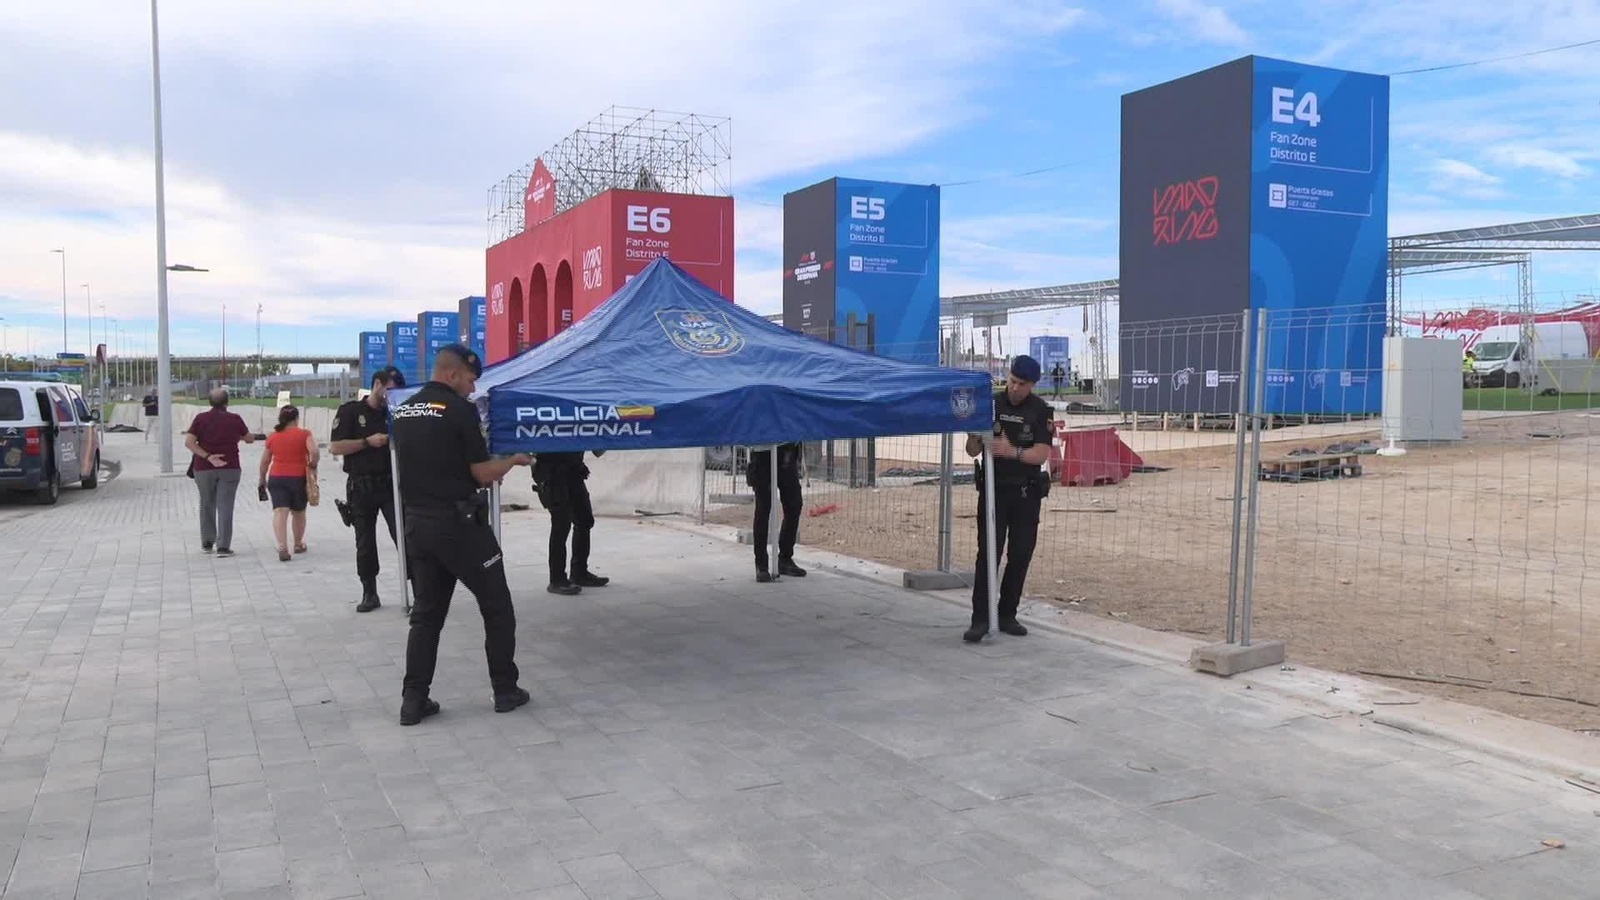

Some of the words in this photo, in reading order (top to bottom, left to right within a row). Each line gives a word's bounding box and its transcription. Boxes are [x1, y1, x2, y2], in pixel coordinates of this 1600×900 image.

[1272, 87, 1320, 127] E4
[1270, 131, 1290, 144] Fan
[1291, 133, 1317, 148] Zone
[1270, 147, 1308, 162] Distrito
[1309, 151, 1317, 163] E
[851, 195, 886, 221] E5
[627, 205, 671, 233] E6
[850, 223, 865, 232] Fan
[865, 225, 886, 234] Zone
[626, 237, 644, 247] Fan
[645, 239, 669, 248] Zone
[850, 233, 879, 243] Distrito
[879, 235, 886, 243] E
[432, 317, 448, 327] E9
[368, 336, 386, 344] E11
[515, 422, 653, 439] NACIONAL
